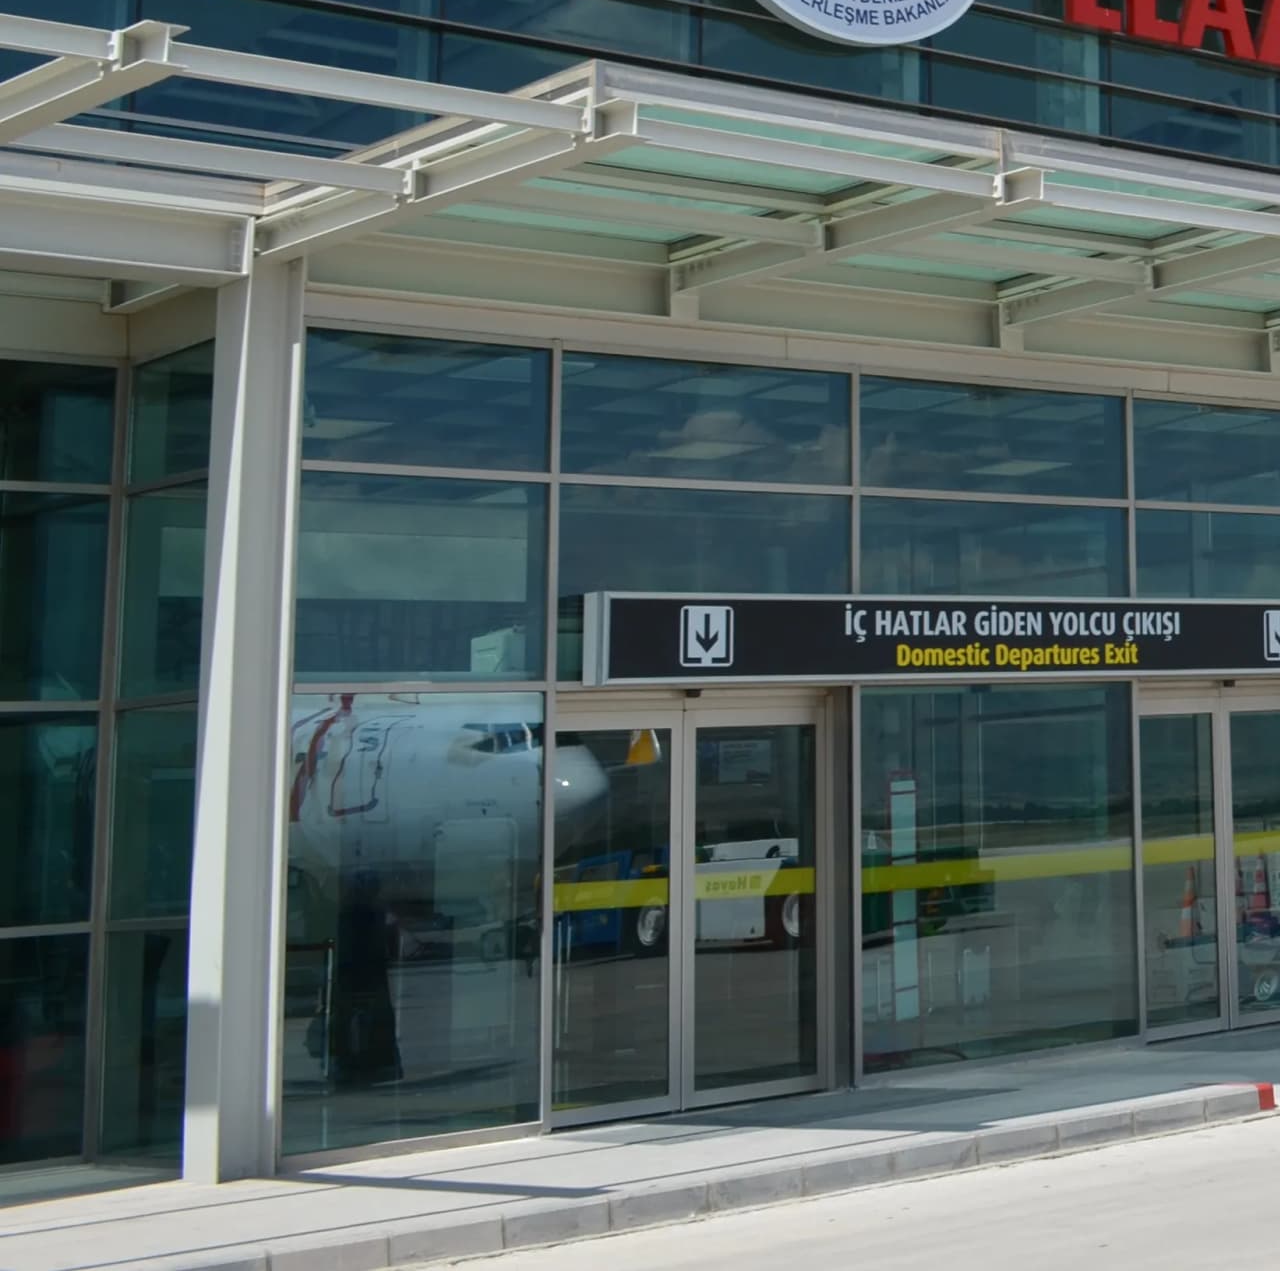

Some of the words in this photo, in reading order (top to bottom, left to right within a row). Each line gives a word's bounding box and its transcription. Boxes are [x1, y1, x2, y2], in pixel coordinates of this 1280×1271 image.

[844, 603, 867, 643] İÇ
[875, 610, 967, 636] HATLAR
[974, 604, 1043, 637] GİDEN
[1049, 611, 1116, 637] YOLCU
[1122, 611, 1181, 642] ÇIKIŞI
[896, 642, 990, 667] Domestic
[995, 643, 1101, 671] Departures
[1104, 642, 1139, 665] Exit
